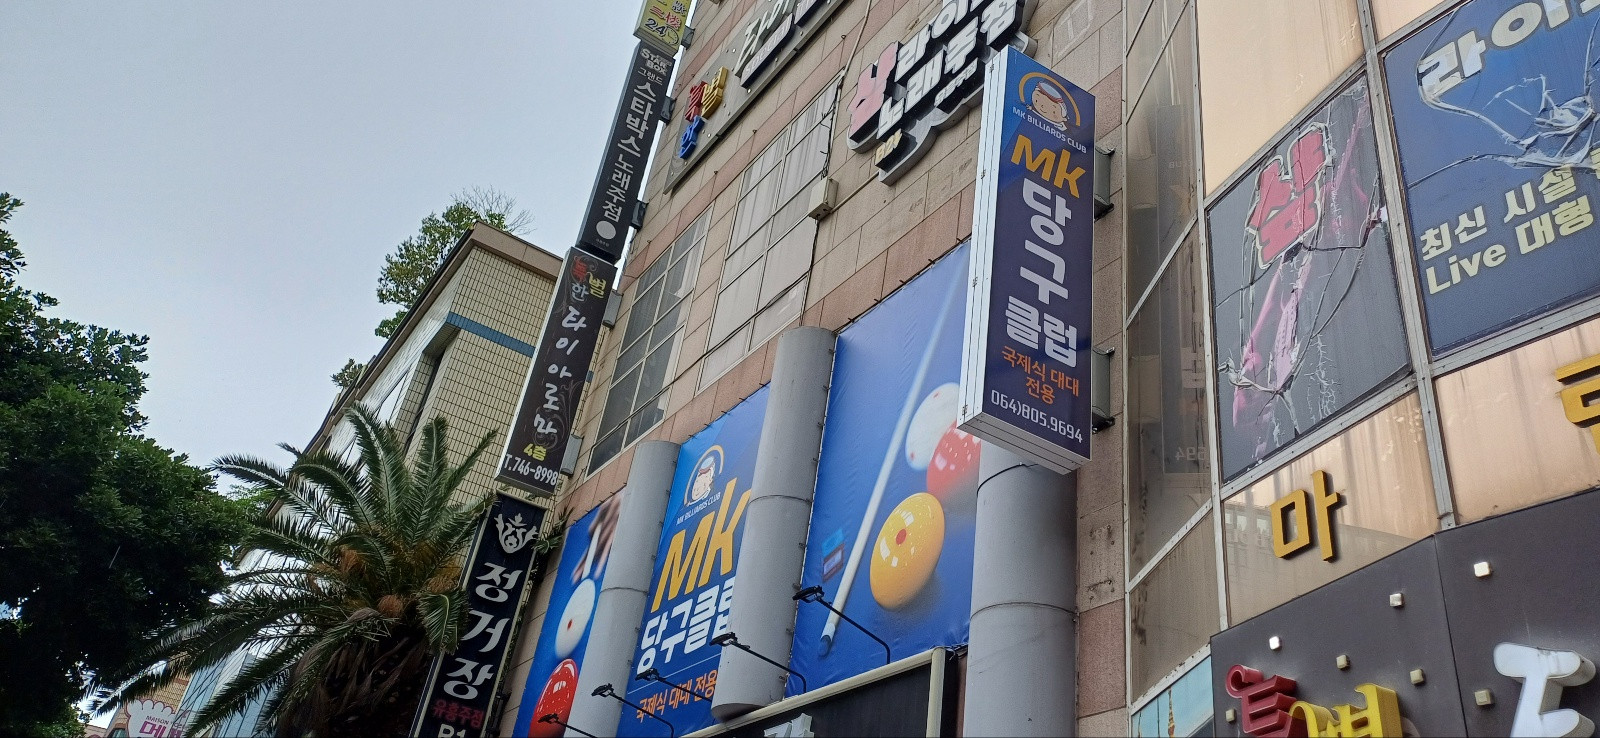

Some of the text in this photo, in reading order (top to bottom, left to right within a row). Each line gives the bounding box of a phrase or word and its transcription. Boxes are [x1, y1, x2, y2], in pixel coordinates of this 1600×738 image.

[644, 18, 667, 37] 24
[893, 0, 985, 83] 라이
[1416, 0, 1600, 99] 라이
[637, 67, 663, 85] 그랜드
[617, 81, 657, 158] 스타박스
[1012, 106, 1087, 154] MK BILLIARDS CLUB
[602, 153, 634, 223] 노래주점
[1419, 165, 1577, 261] 최신 시설
[1425, 194, 1594, 296] Live 대형
[1001, 345, 1079, 397] 국제식 대대
[1025, 376, 1056, 405] 전용
[991, 389, 1083, 443] 064)805.9694
[504, 453, 558, 486] T.746-8998
[523, 443, 547, 461] 4층
[684, 501, 708, 521] BILLIARDS
[707, 491, 721, 506] CLUB
[443, 562, 523, 700] 정거장
[432, 699, 485, 729] 유흥주점
